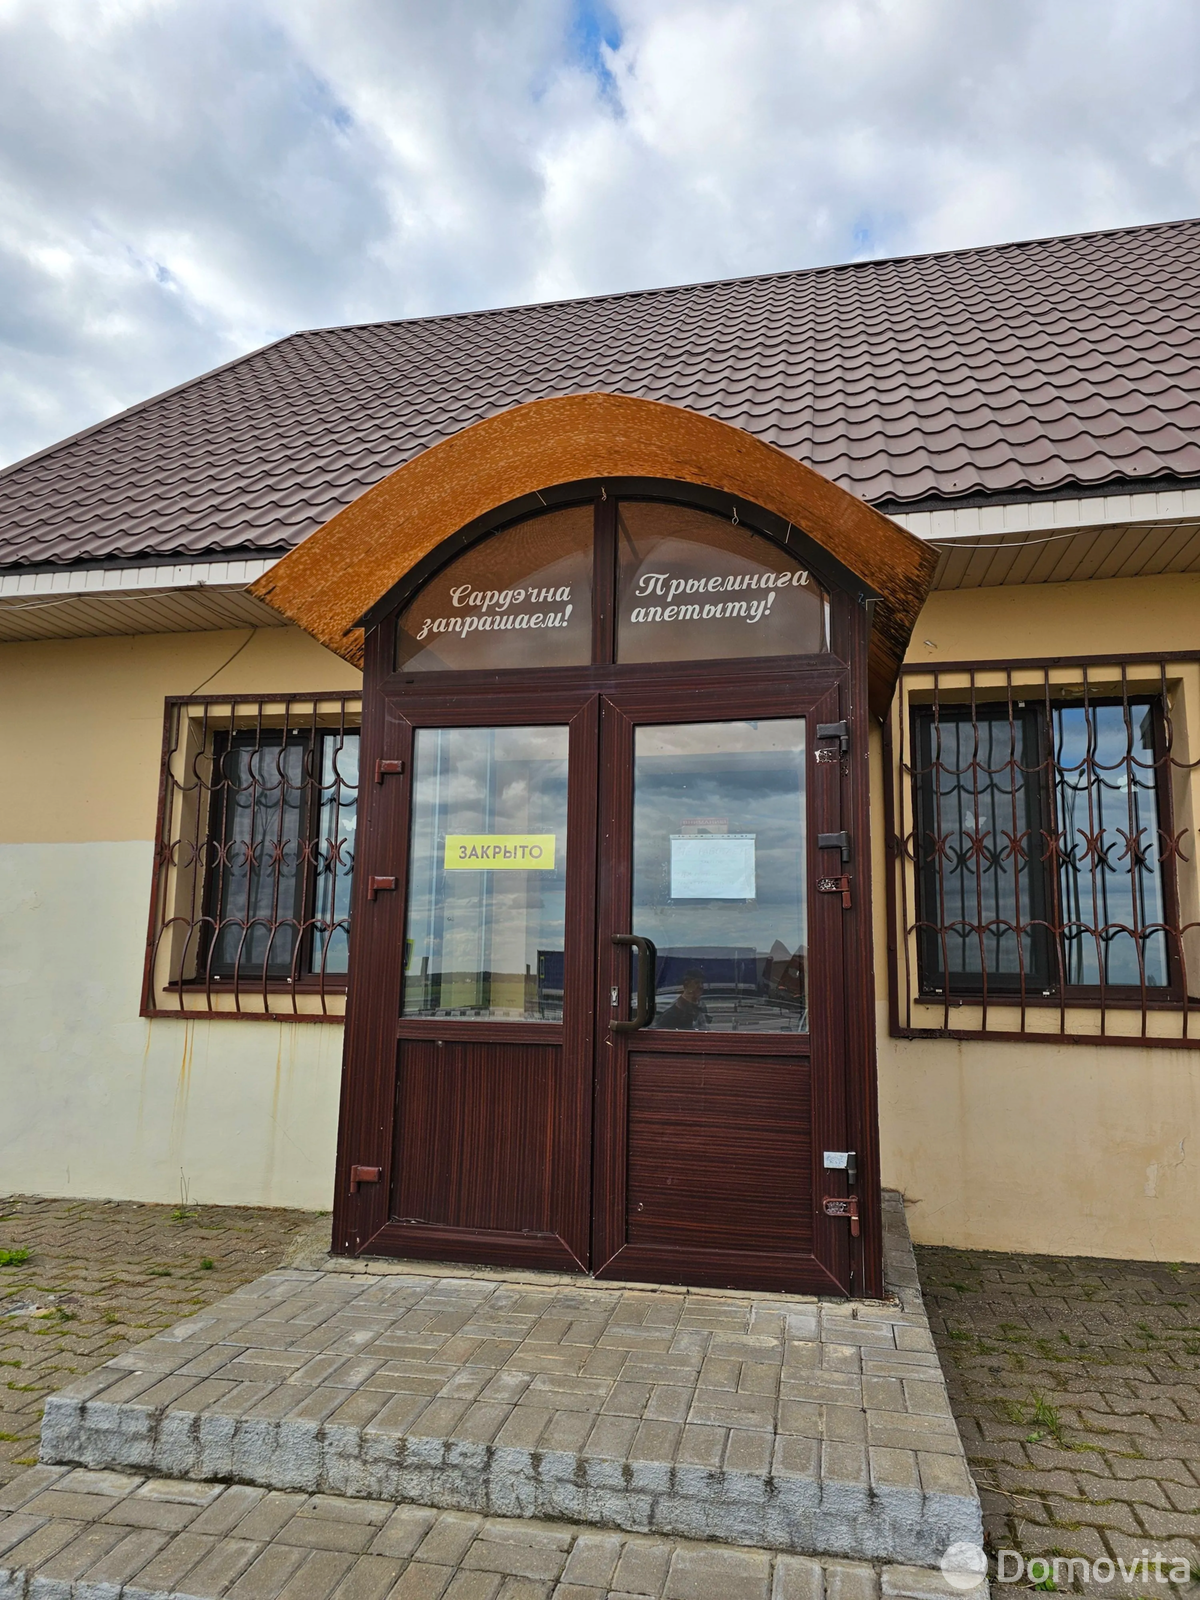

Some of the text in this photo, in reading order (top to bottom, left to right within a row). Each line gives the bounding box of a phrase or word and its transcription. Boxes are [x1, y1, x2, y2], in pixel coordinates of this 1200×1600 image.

[450, 584, 571, 612] Сардэчна
[635, 570, 810, 602] Прыемнага
[416, 604, 573, 640] запрашаем!
[630, 591, 776, 623] апетыту!
[458, 845, 543, 859] ЗАКРЫТО
